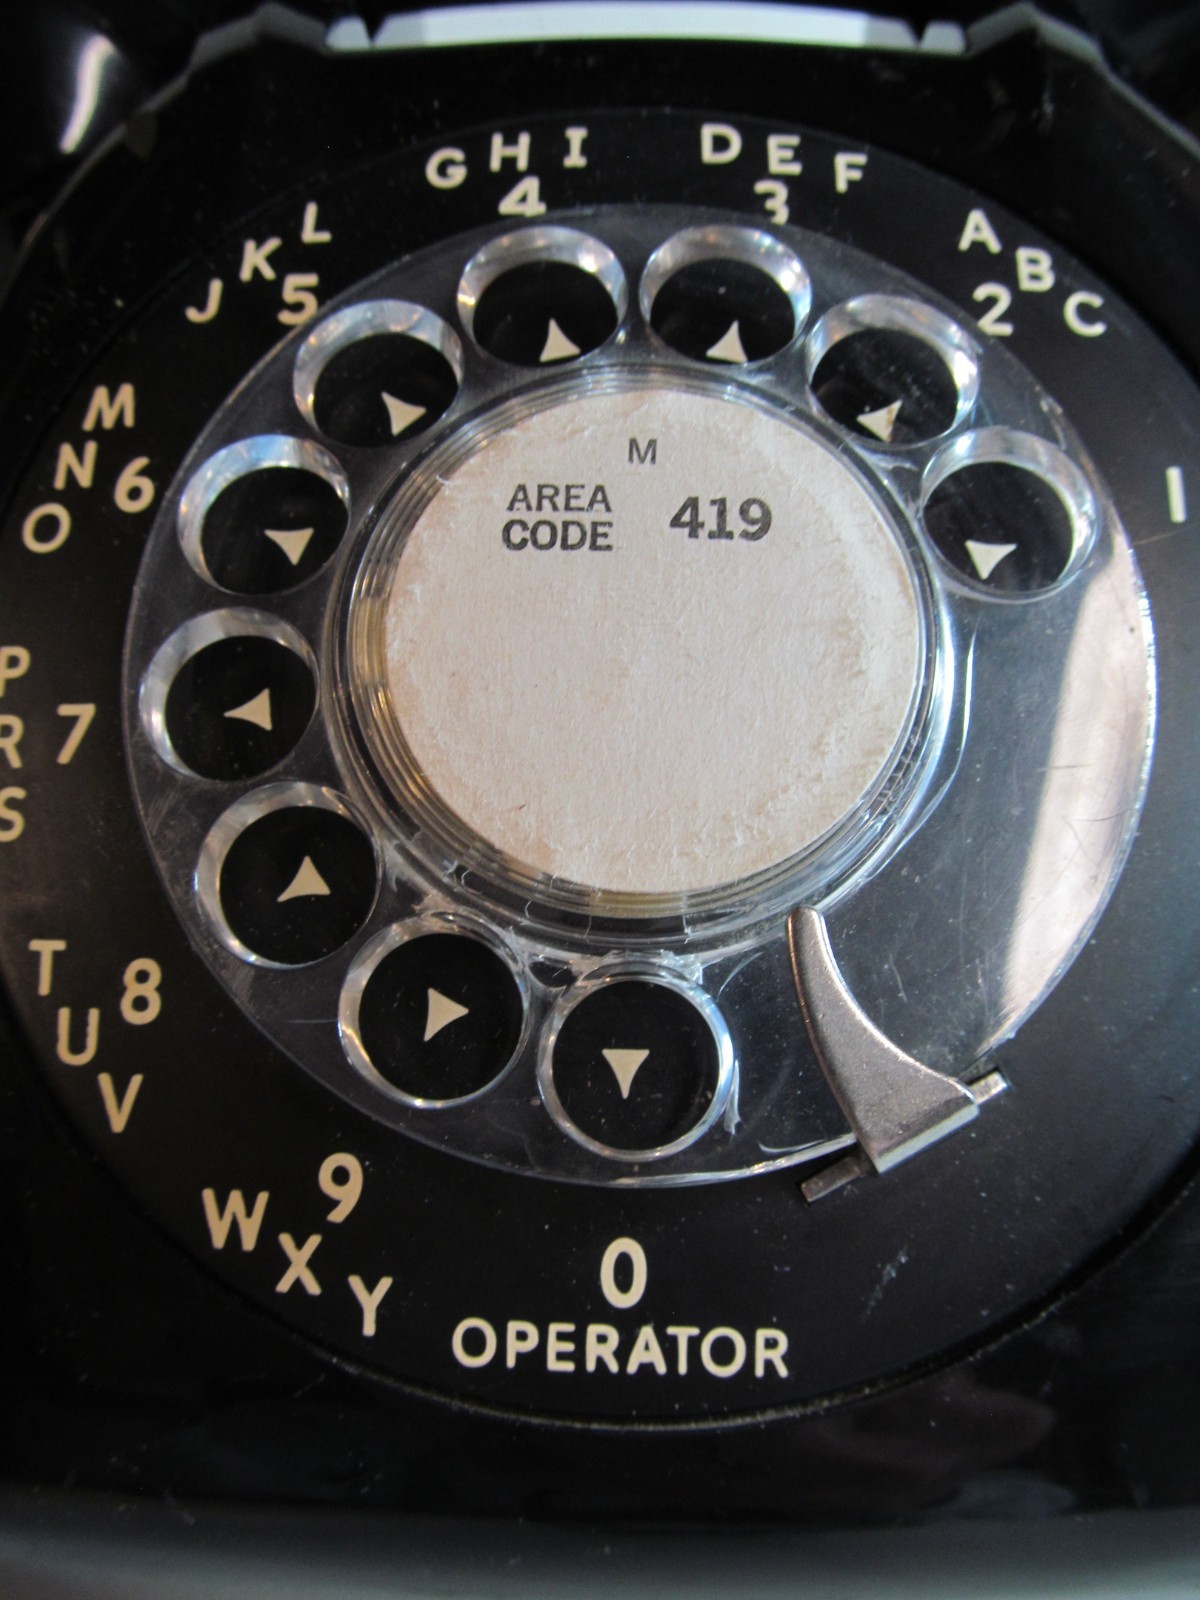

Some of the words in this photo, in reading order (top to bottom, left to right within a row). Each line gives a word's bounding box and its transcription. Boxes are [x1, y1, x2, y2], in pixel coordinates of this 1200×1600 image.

[425, 148, 467, 188] G
[490, 132, 531, 172] H
[700, 123, 742, 164] D
[767, 134, 803, 175] E
[834, 152, 868, 193] F
[498, 176, 547, 218] 4
[754, 179, 790, 226] 3
[186, 279, 223, 322] J
[240, 238, 281, 281] K
[301, 202, 331, 243] L
[958, 209, 1002, 254] A
[1015, 246, 1056, 292] B
[1063, 290, 1107, 337] C
[278, 273, 320, 326] 5
[972, 282, 1014, 337] 2
[83, 384, 134, 431] M
[54, 441, 97, 490] N
[627, 437, 658, 464] M
[114, 457, 154, 513] 6
[505, 484, 612, 513] AREA
[23, 503, 71, 553] O
[501, 518, 613, 552] CODE
[668, 496, 772, 541] 419
[0, 645, 31, 698] P
[56, 702, 97, 765] 7
[0, 786, 27, 842] S
[29, 939, 66, 996] T
[120, 958, 161, 1025] 8
[57, 1007, 99, 1066] U
[98, 1073, 143, 1133] V
[318, 1152, 363, 1223] 9
[202, 1188, 269, 1251] W
[276, 1233, 322, 1295] X
[348, 1275, 393, 1337] Y
[600, 1237, 648, 1309] 0
[452, 1317, 790, 1378] OPERATOR
